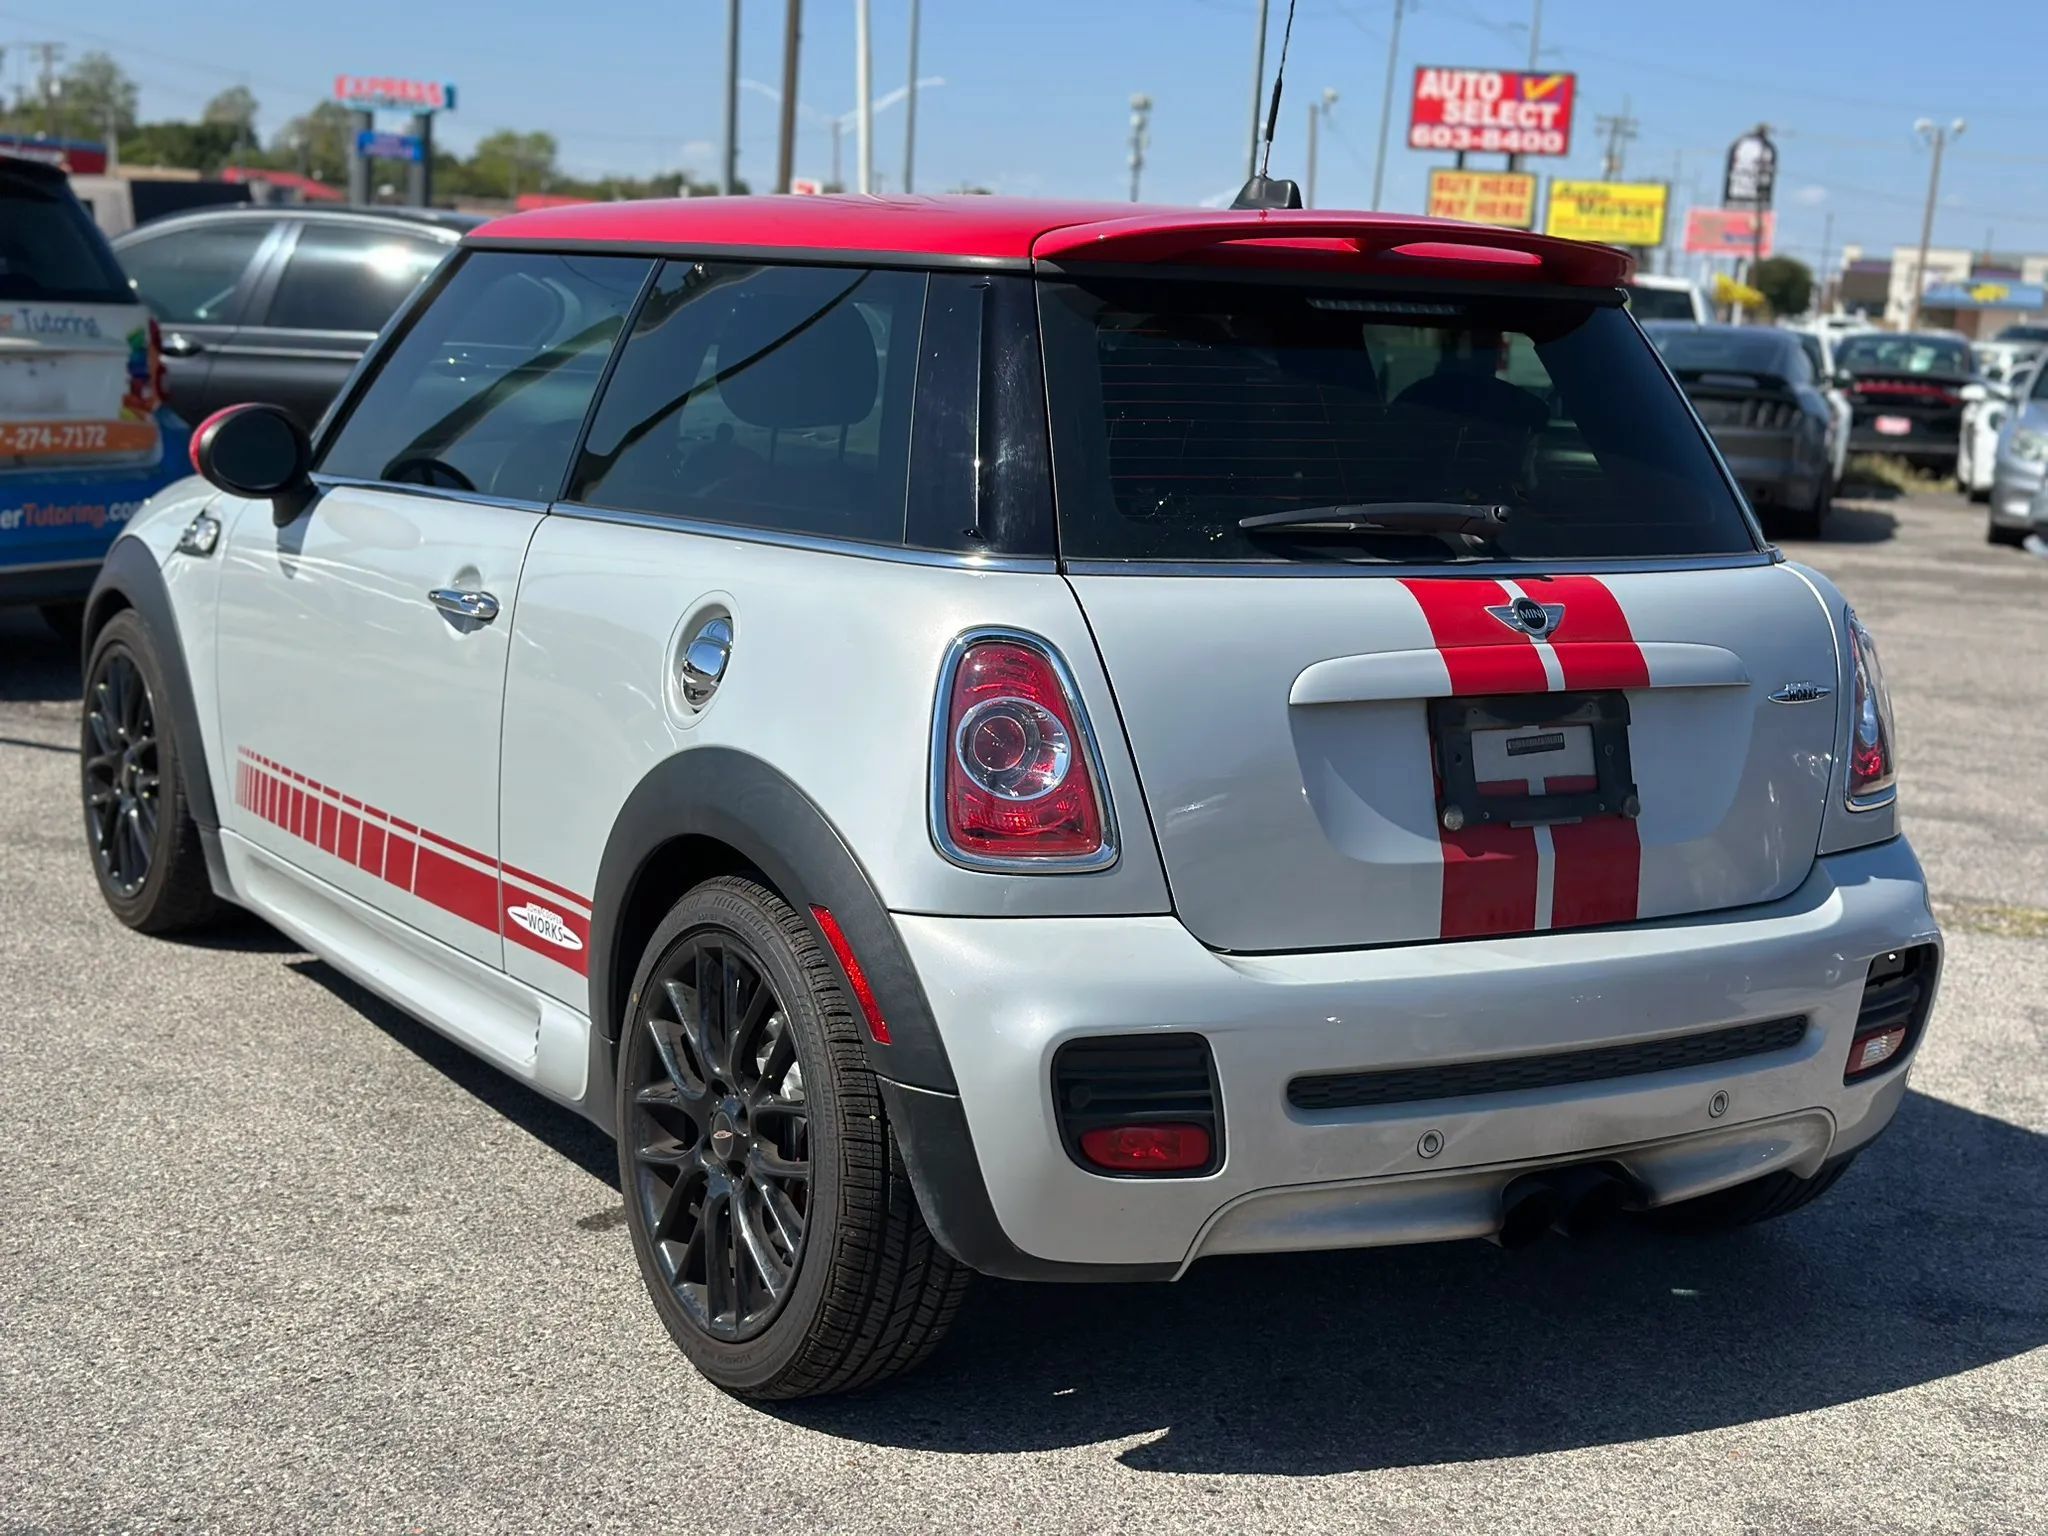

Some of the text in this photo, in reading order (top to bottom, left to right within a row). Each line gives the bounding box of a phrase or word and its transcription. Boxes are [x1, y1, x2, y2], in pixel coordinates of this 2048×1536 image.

[335, 75, 443, 106] EXPRESS
[1416, 69, 1503, 100] AUTO
[1441, 98, 1561, 130] SELECT
[1411, 123, 1564, 153] 603-8400
[1436, 175, 1527, 198] BUY HERE
[1432, 195, 1525, 220] PAY HERE
[18, 307, 102, 337] Tutoring
[1519, 608, 1545, 620] MINI
[528, 912, 564, 941] WORKS
